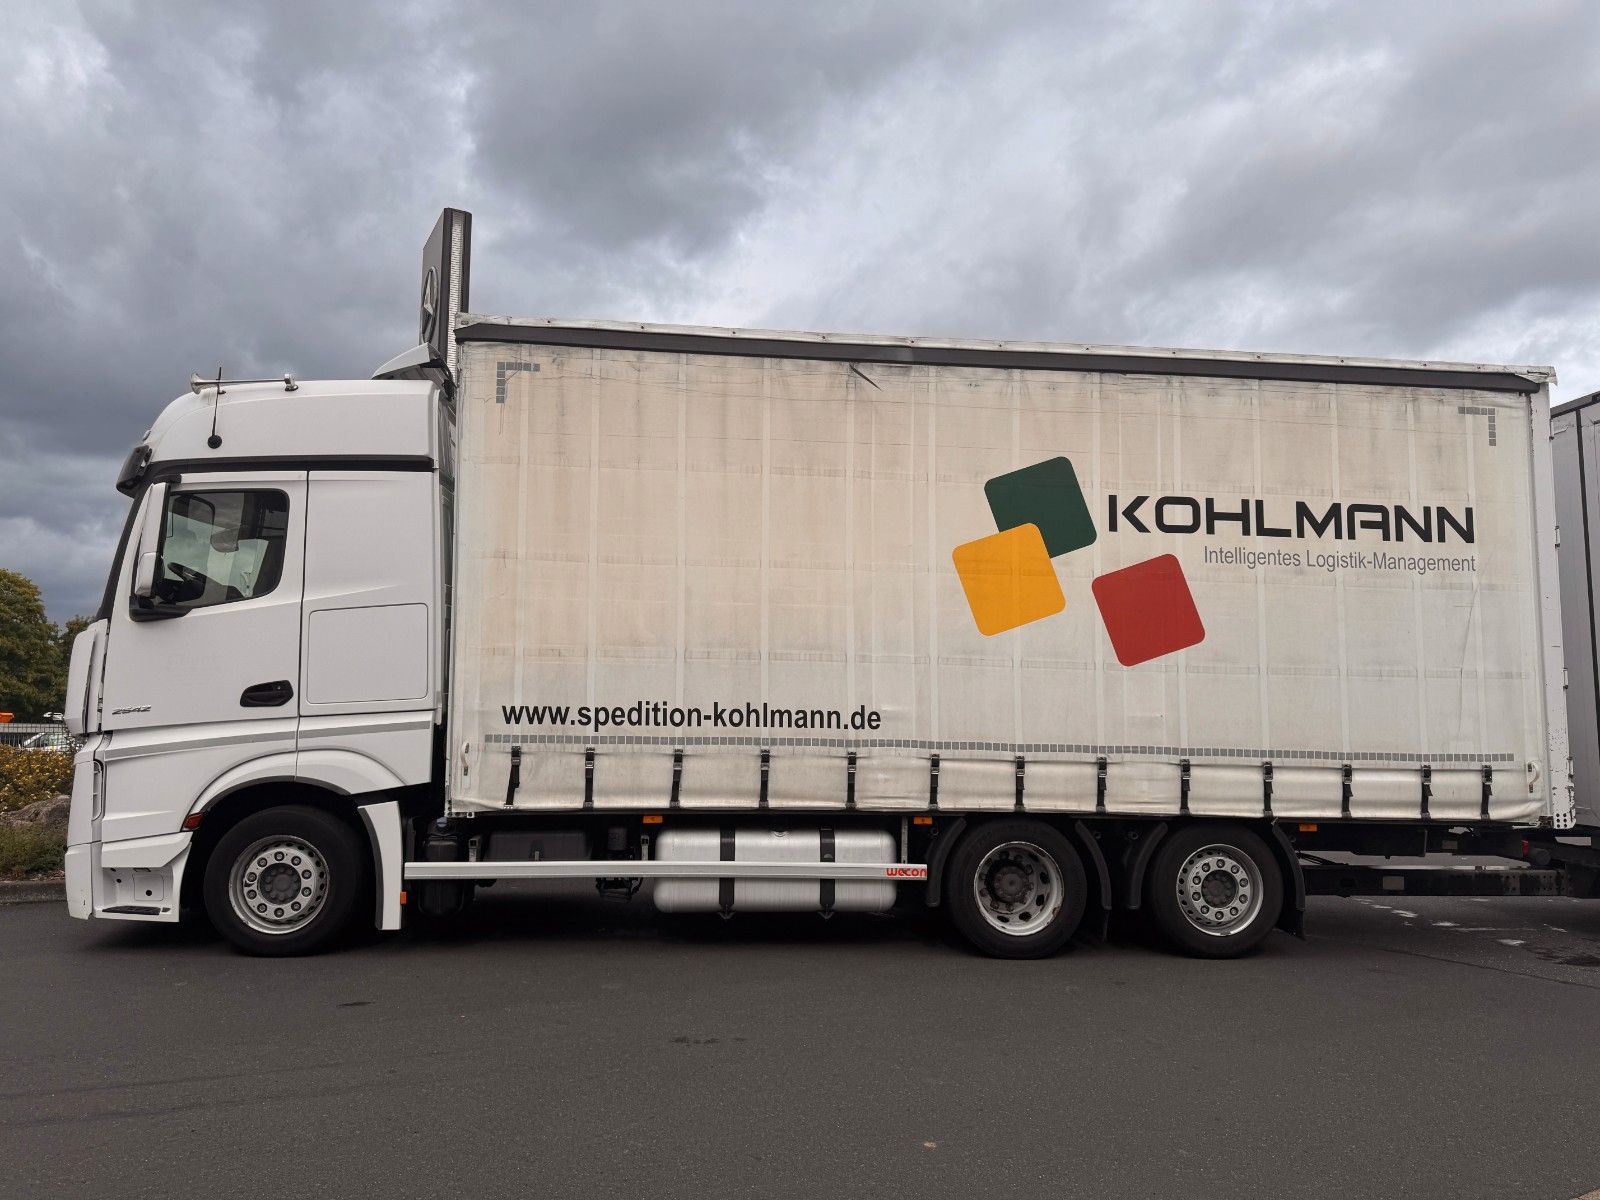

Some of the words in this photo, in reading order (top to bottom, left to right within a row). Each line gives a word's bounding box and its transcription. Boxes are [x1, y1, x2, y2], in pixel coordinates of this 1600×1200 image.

[1108, 494, 1475, 544] KOHLMANN
[1204, 545, 1302, 570] Intelligentes
[1306, 549, 1477, 576] Logistik-Management
[501, 700, 882, 733] www.spedition-kohlmann.de
[886, 867, 928, 878] wecon
